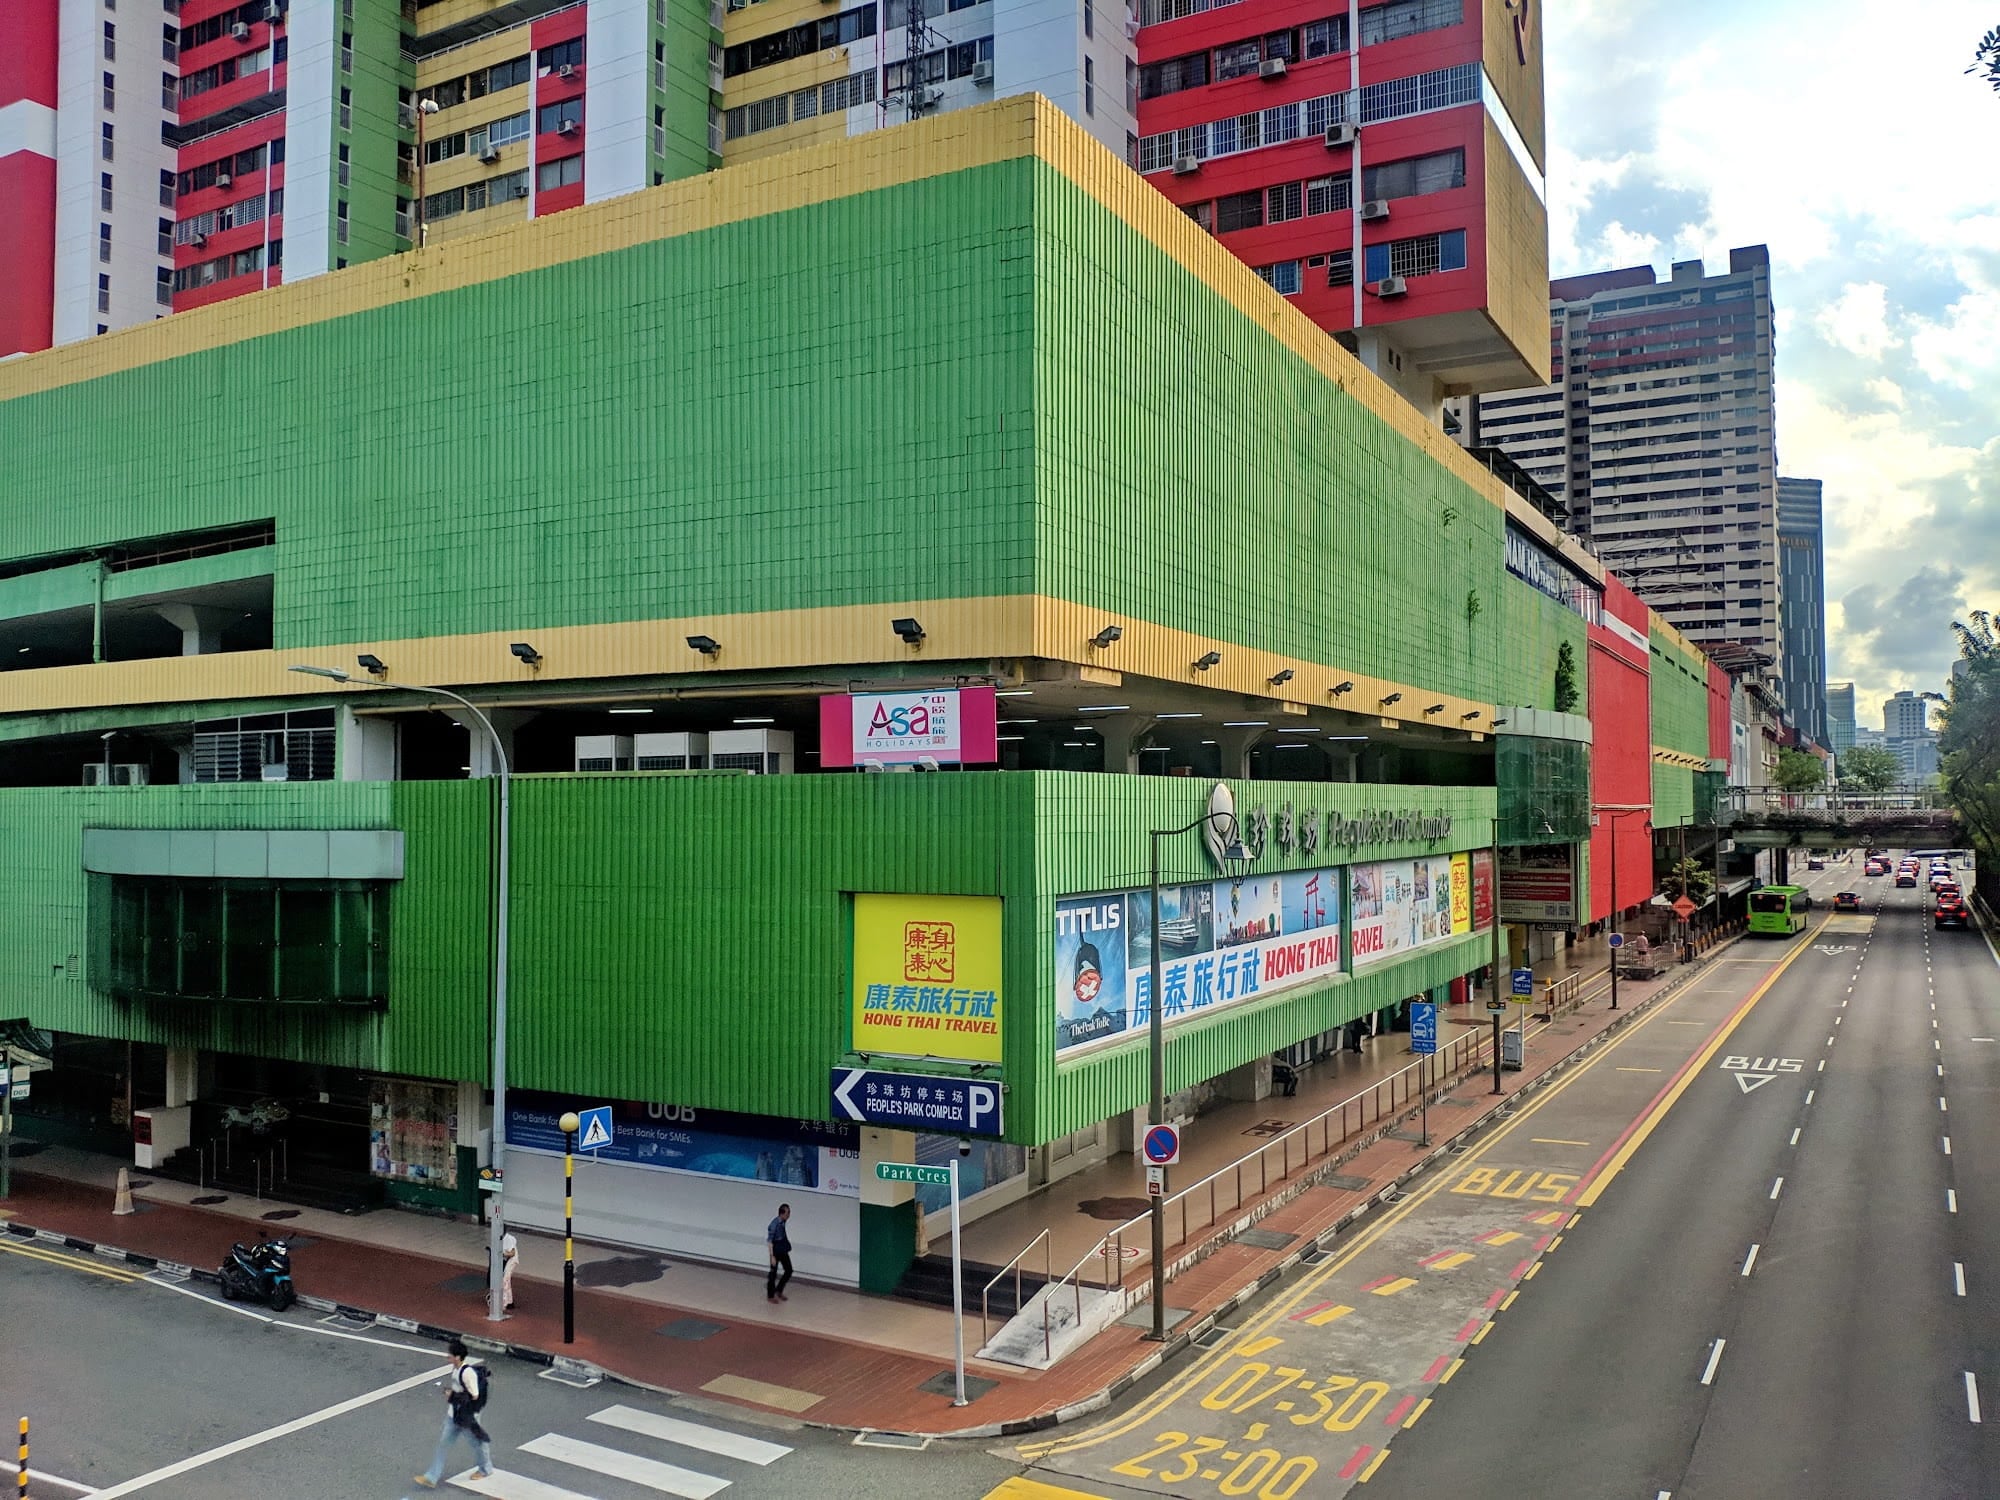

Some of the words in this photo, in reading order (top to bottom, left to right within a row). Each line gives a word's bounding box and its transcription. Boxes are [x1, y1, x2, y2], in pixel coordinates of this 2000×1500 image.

[1526, 547, 1540, 584] HO
[867, 700, 930, 737] Asa
[866, 738, 931, 748] HOLIDAYS
[1056, 903, 1120, 936] TITLIS
[1264, 942, 1306, 982] HONG
[1308, 934, 1339, 969] THAI
[1352, 924, 1385, 957] RAVEL
[863, 983, 998, 1018] 康泰旅行社
[863, 1013, 903, 1027] HONG
[907, 1015, 940, 1030] THAI
[944, 1018, 998, 1035] TRAVEL
[1719, 1055, 1805, 1073] BUS
[866, 1082, 964, 1104] 珍珠坊停车场
[512, 1111, 529, 1121] One
[529, 1114, 547, 1125] Bank
[549, 1114, 559, 1126] for
[648, 1102, 696, 1122] UOB
[866, 1097, 903, 1114] PEOPLE'S
[903, 1101, 924, 1117] PARK
[925, 1104, 963, 1121] COMPLEX
[969, 1085, 995, 1129] P
[617, 1125, 635, 1136] Best
[635, 1127, 656, 1139] Bank
[656, 1129, 669, 1140] for
[799, 1119, 849, 1136] 大华银行
[839, 1149, 860, 1160] UOB
[882, 1165, 913, 1181] Park
[917, 1168, 948, 1184] Cres
[1449, 1167, 1581, 1203] BUS
[1200, 1362, 1391, 1432] 07:30
[1109, 1431, 1320, 1500] 23:00
